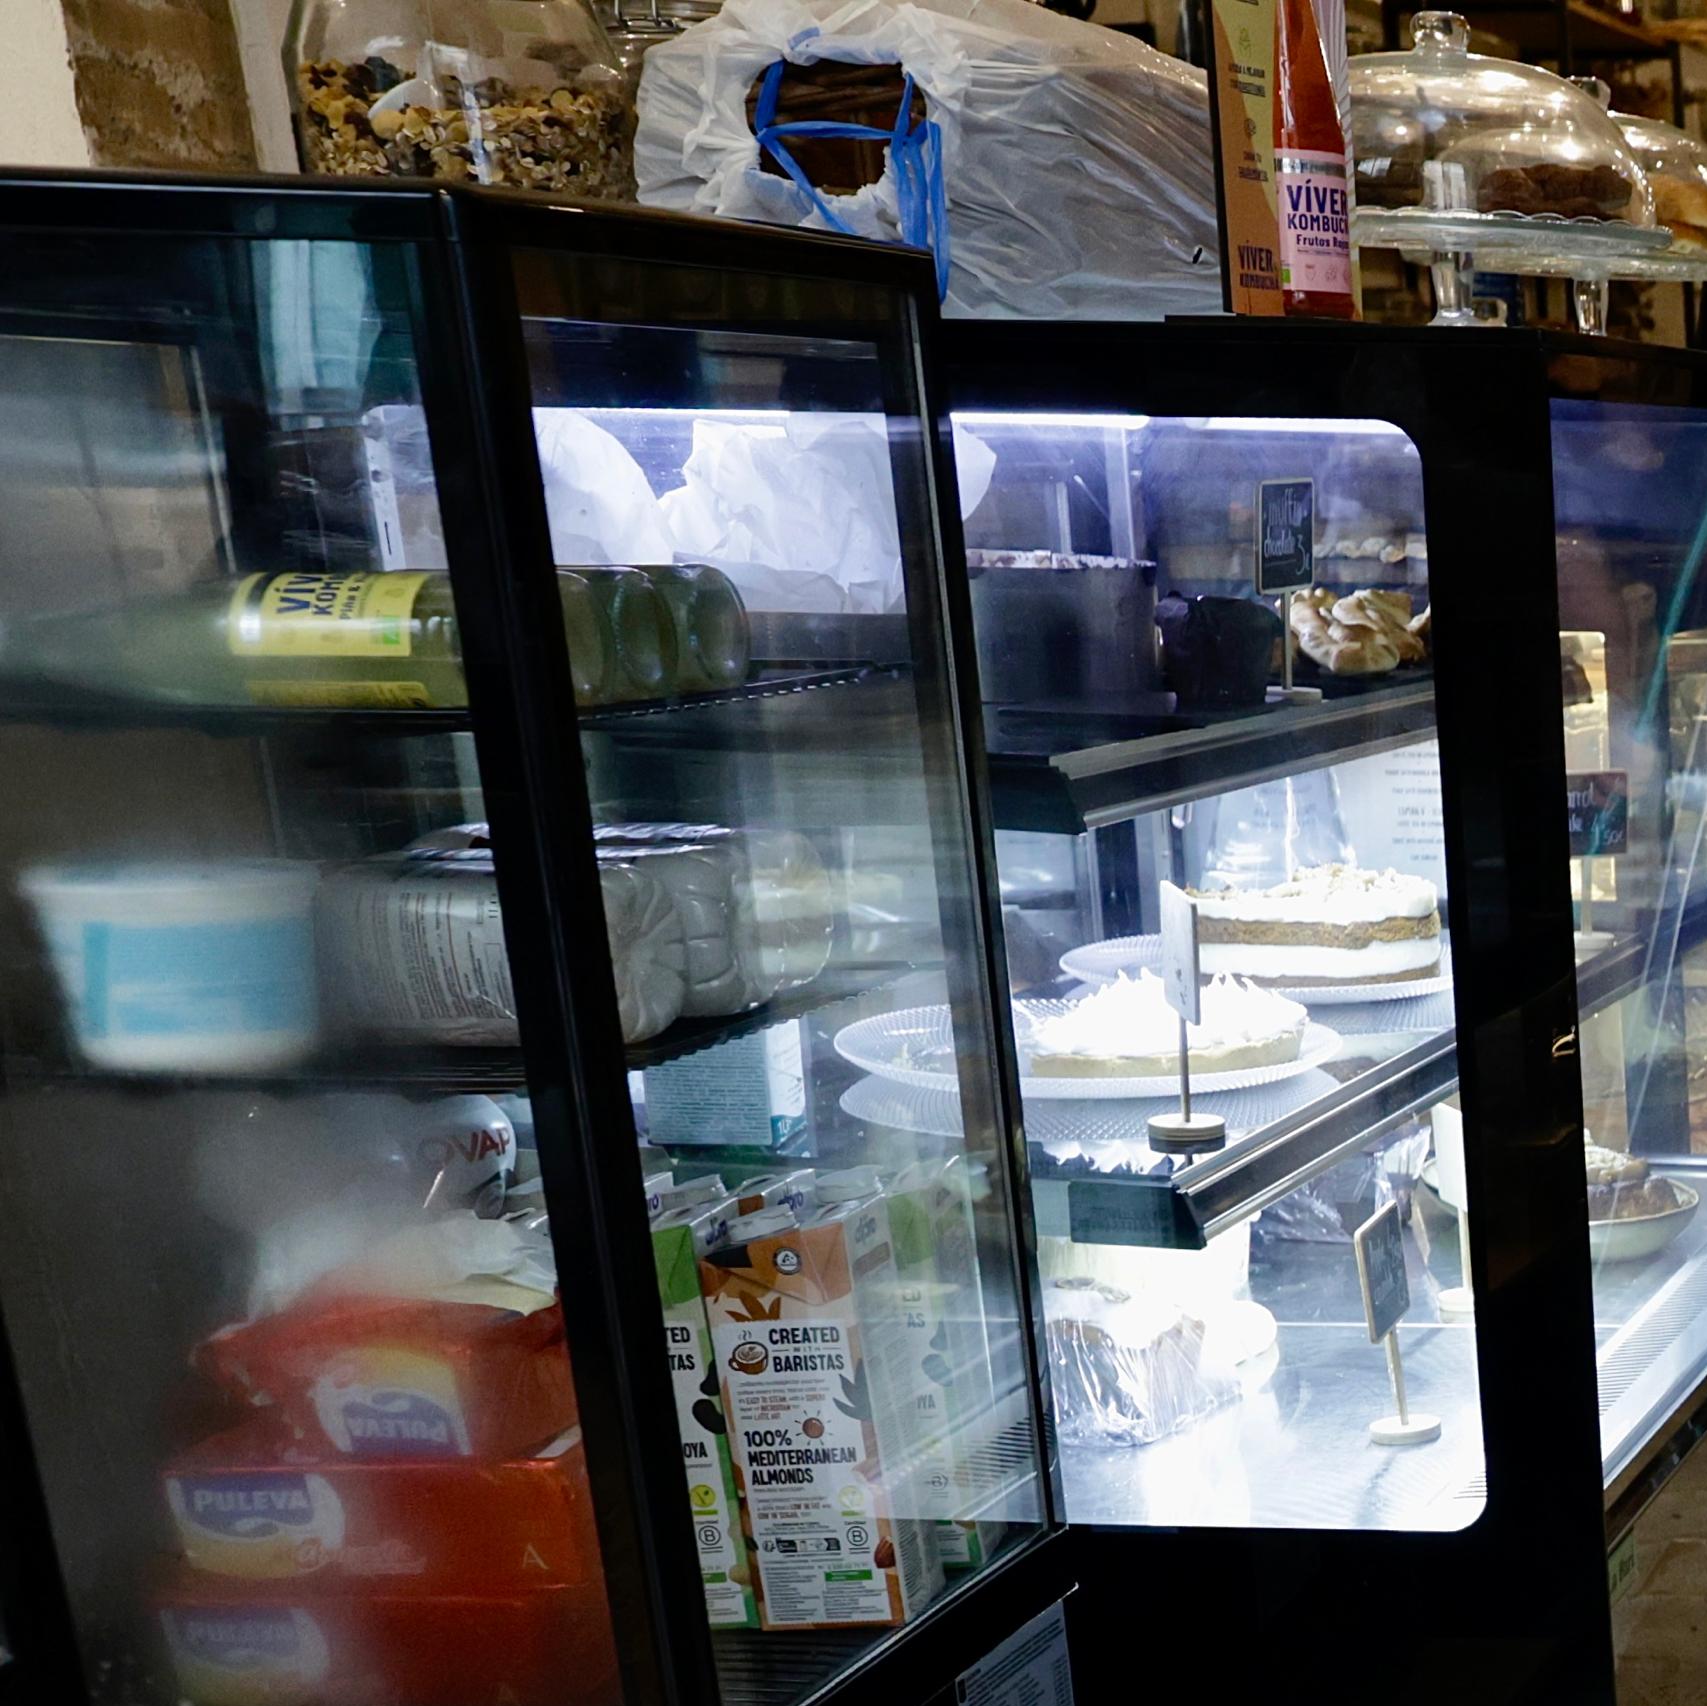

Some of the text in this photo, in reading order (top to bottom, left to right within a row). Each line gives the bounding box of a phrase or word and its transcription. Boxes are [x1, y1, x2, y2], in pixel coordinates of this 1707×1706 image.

[1286, 178, 1347, 217] VÍVER
[1296, 234, 1330, 248] Frutos
[1237, 240, 1273, 273] VÍVER
[274, 574, 323, 614] VÍV
[768, 1326, 840, 1345] CREATED
[772, 1354, 845, 1373] BARISTAS
[743, 1429, 793, 1448] 100%
[683, 1441, 708, 1459] OYA
[747, 1447, 857, 1467] MEDITERRANEAN
[751, 1467, 814, 1486] ALMONDS
[193, 1488, 310, 1514] PULEVA
